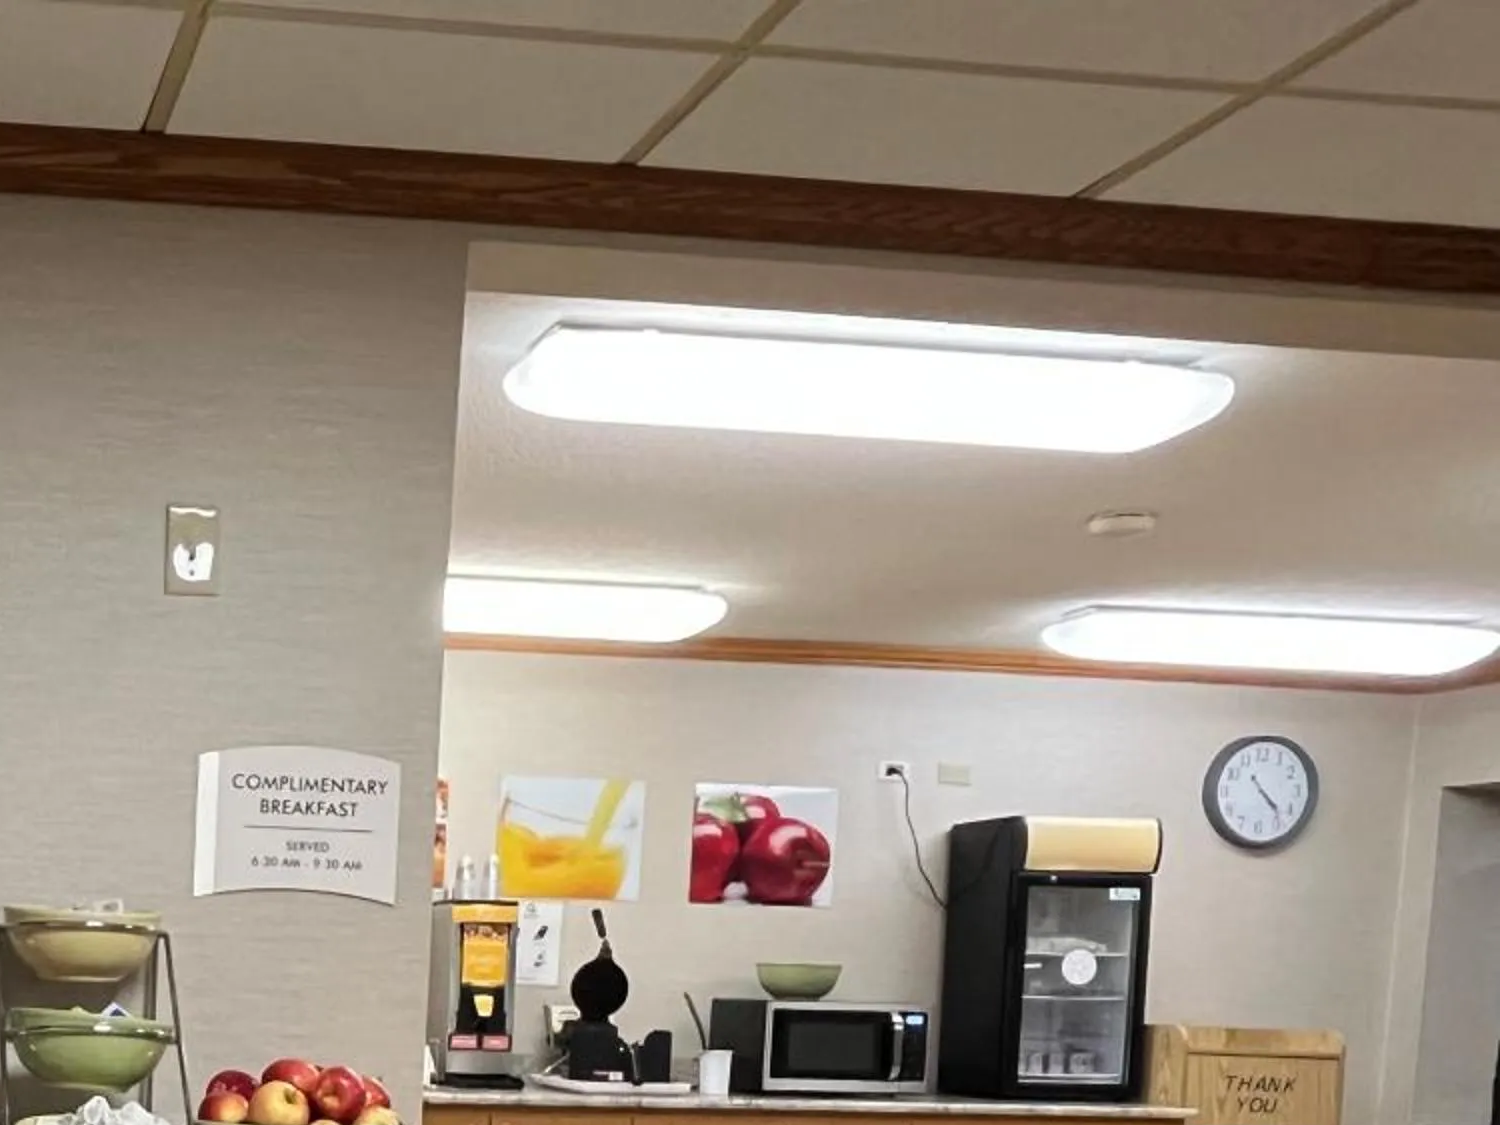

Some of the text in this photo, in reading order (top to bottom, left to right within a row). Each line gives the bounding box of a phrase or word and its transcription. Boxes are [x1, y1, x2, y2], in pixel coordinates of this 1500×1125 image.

[231, 773, 389, 795] COMPLIMENTARY
[259, 798, 360, 817] BREAKFAST
[285, 840, 330, 853] SERVED
[251, 856, 279, 868] 630
[282, 857, 301, 868] AM
[313, 858, 339, 870] 930
[343, 859, 363, 870] AM
[1226, 1072, 1299, 1092] THANK
[1237, 1097, 1277, 1113] YOU
